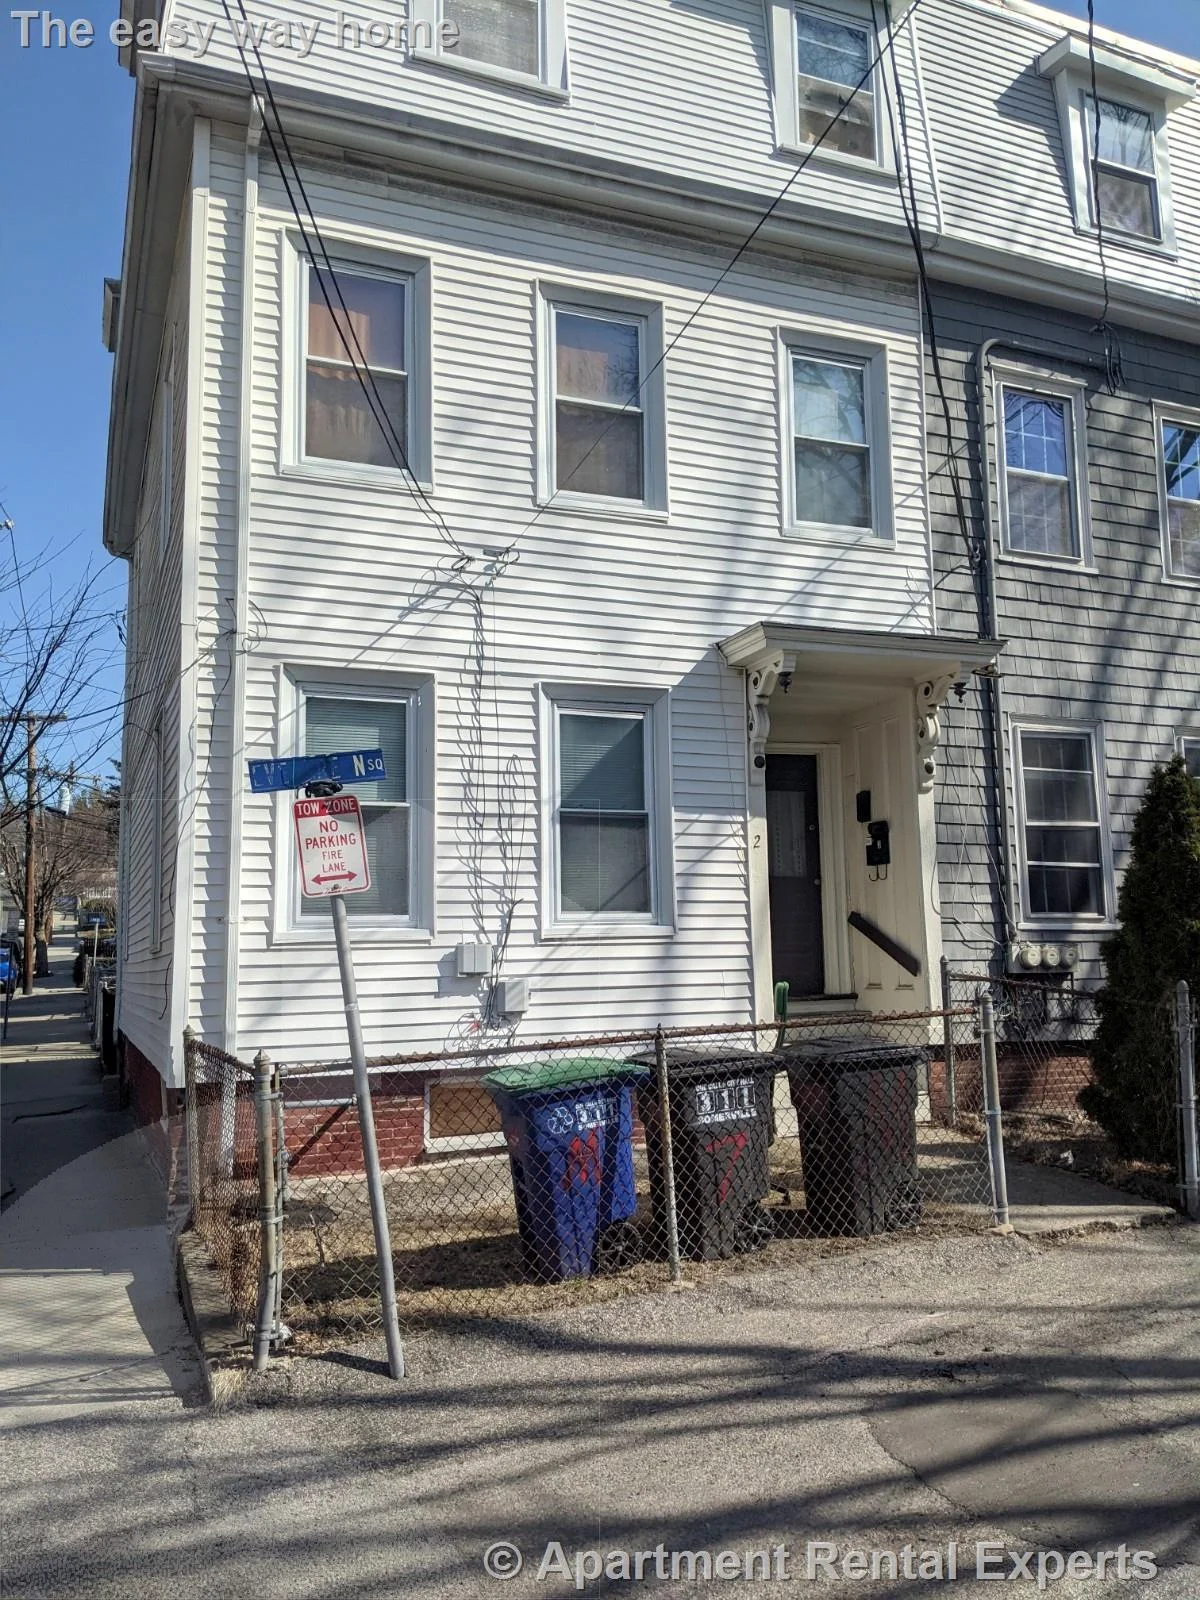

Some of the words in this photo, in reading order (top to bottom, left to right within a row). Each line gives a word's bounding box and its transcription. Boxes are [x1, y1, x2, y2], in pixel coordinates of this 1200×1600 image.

[367, 758, 384, 772] SQ
[296, 803, 320, 816] TOW
[325, 799, 357, 813] ZONE
[319, 820, 339, 833] NO
[305, 833, 357, 850] PARKING
[753, 834, 761, 848] 2
[322, 850, 344, 860] FIRE
[322, 861, 347, 873] LANE
[698, 1086, 753, 1113] 311
